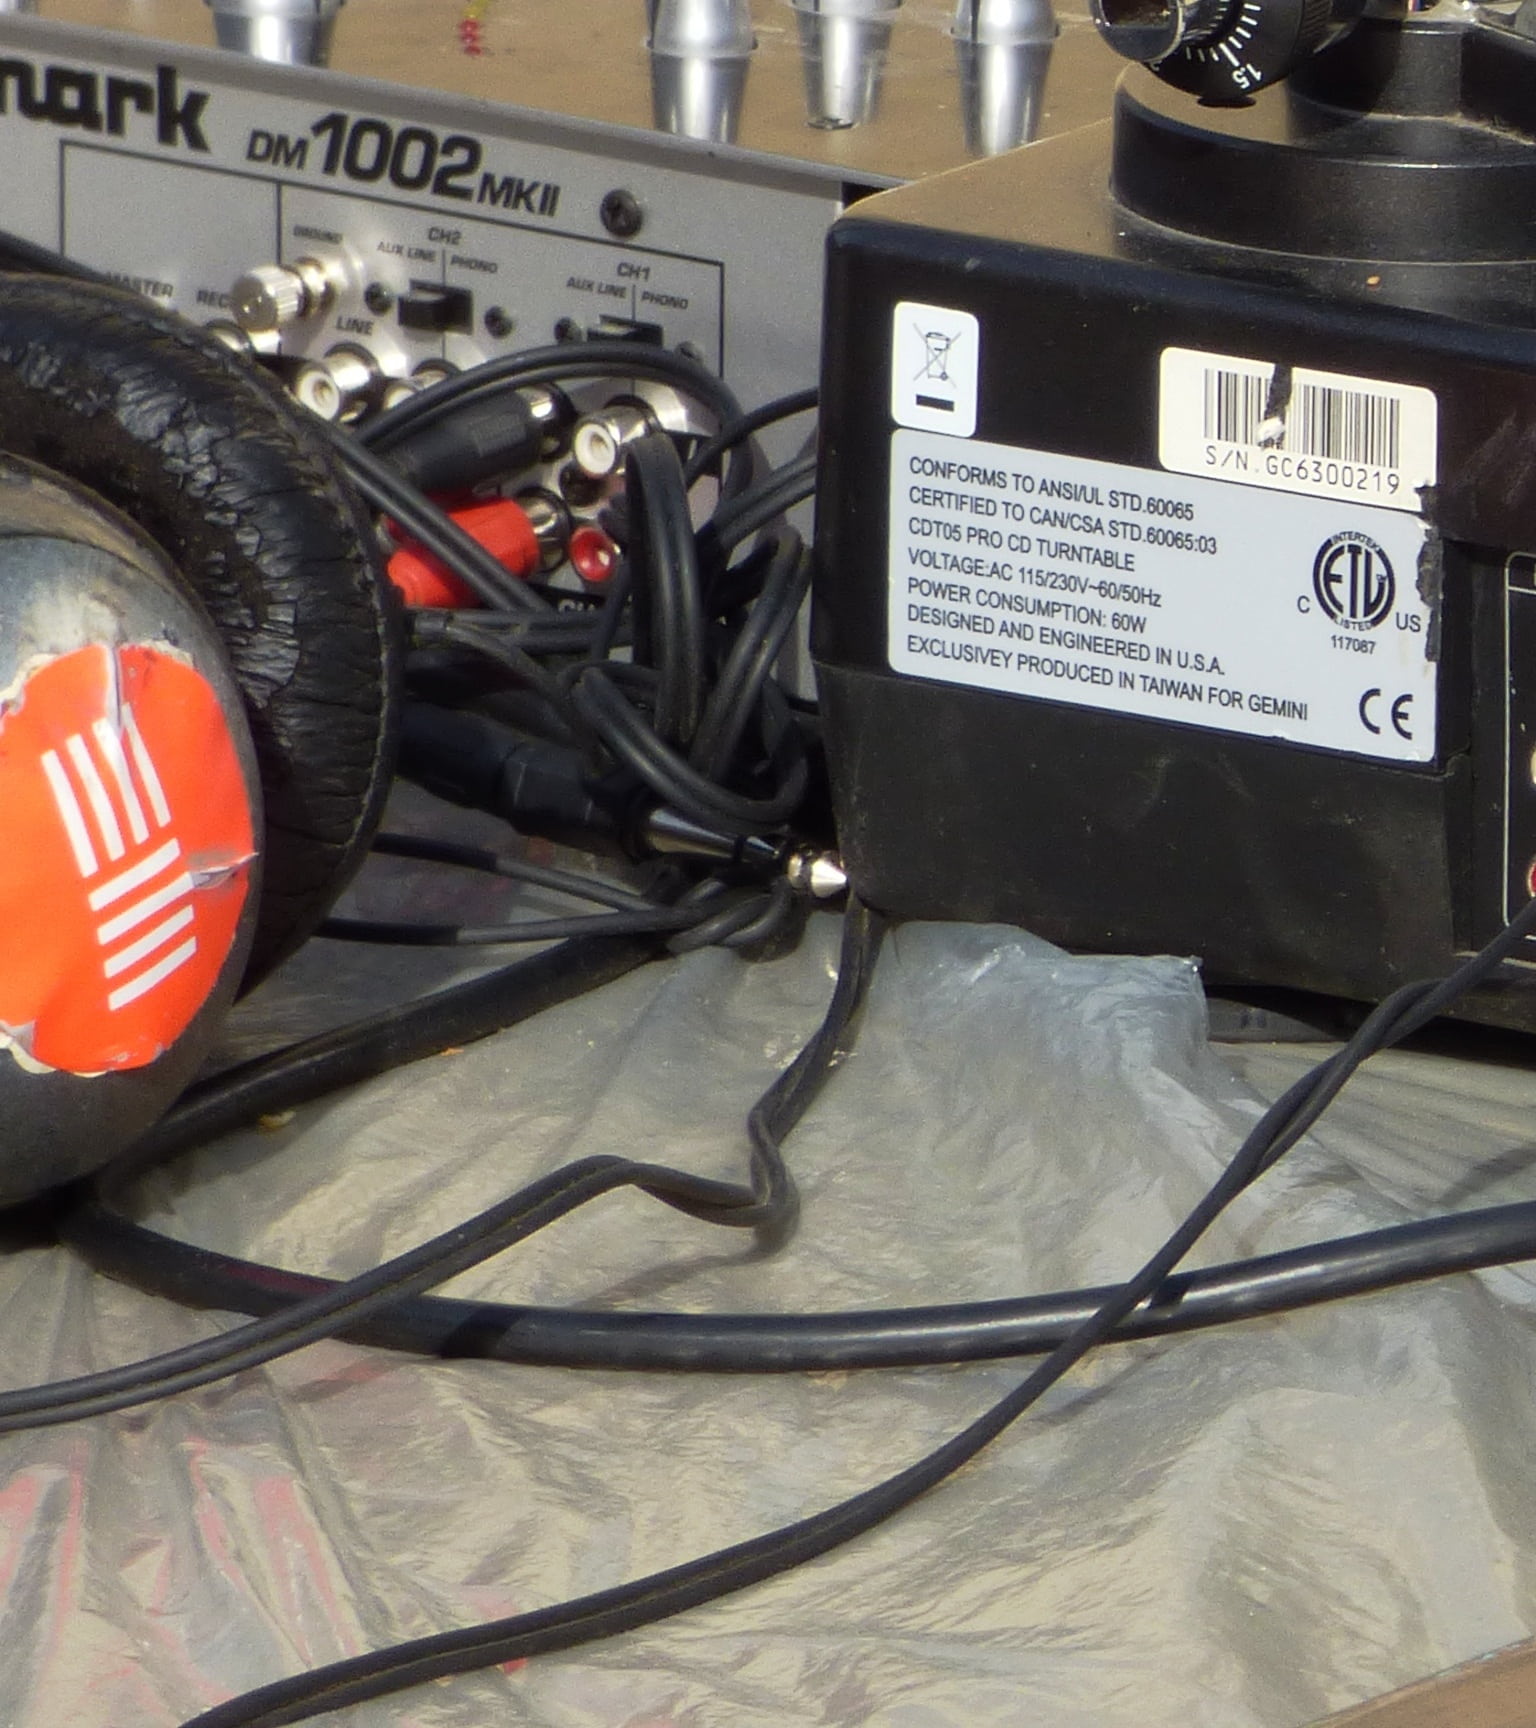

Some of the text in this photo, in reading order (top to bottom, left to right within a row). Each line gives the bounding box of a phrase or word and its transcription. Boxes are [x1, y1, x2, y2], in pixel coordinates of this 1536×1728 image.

[428, 227, 461, 246] CH2
[407, 247, 437, 263] LINE
[450, 256, 498, 274] PHONO
[617, 262, 650, 281] CH1
[566, 277, 627, 299] AUX LINE
[641, 291, 689, 310] PHONO
[336, 316, 373, 335] LINE
[909, 456, 1194, 521] CONFORMS TO ANSI/UL STD.60065
[909, 486, 1217, 555] CERTIFIED TO CAN/CSA STD.60065:03
[908, 517, 1135, 572] CDT05 PRO CD TURNTABLE
[908, 577, 1147, 633] POWER CONSUMPTION: 60W
[1297, 595, 1311, 614] C
[1395, 612, 1422, 633] US
[908, 604, 995, 634] DESIGNED
[998, 620, 1034, 642] AND
[1039, 626, 1150, 662] ENGINEERED
[1156, 647, 1173, 666] IN
[907, 634, 1308, 721] EXCLUSIVEY PRODUCED IN TAIWAN FOR GEMINI
[1359, 688, 1413, 741] CE
